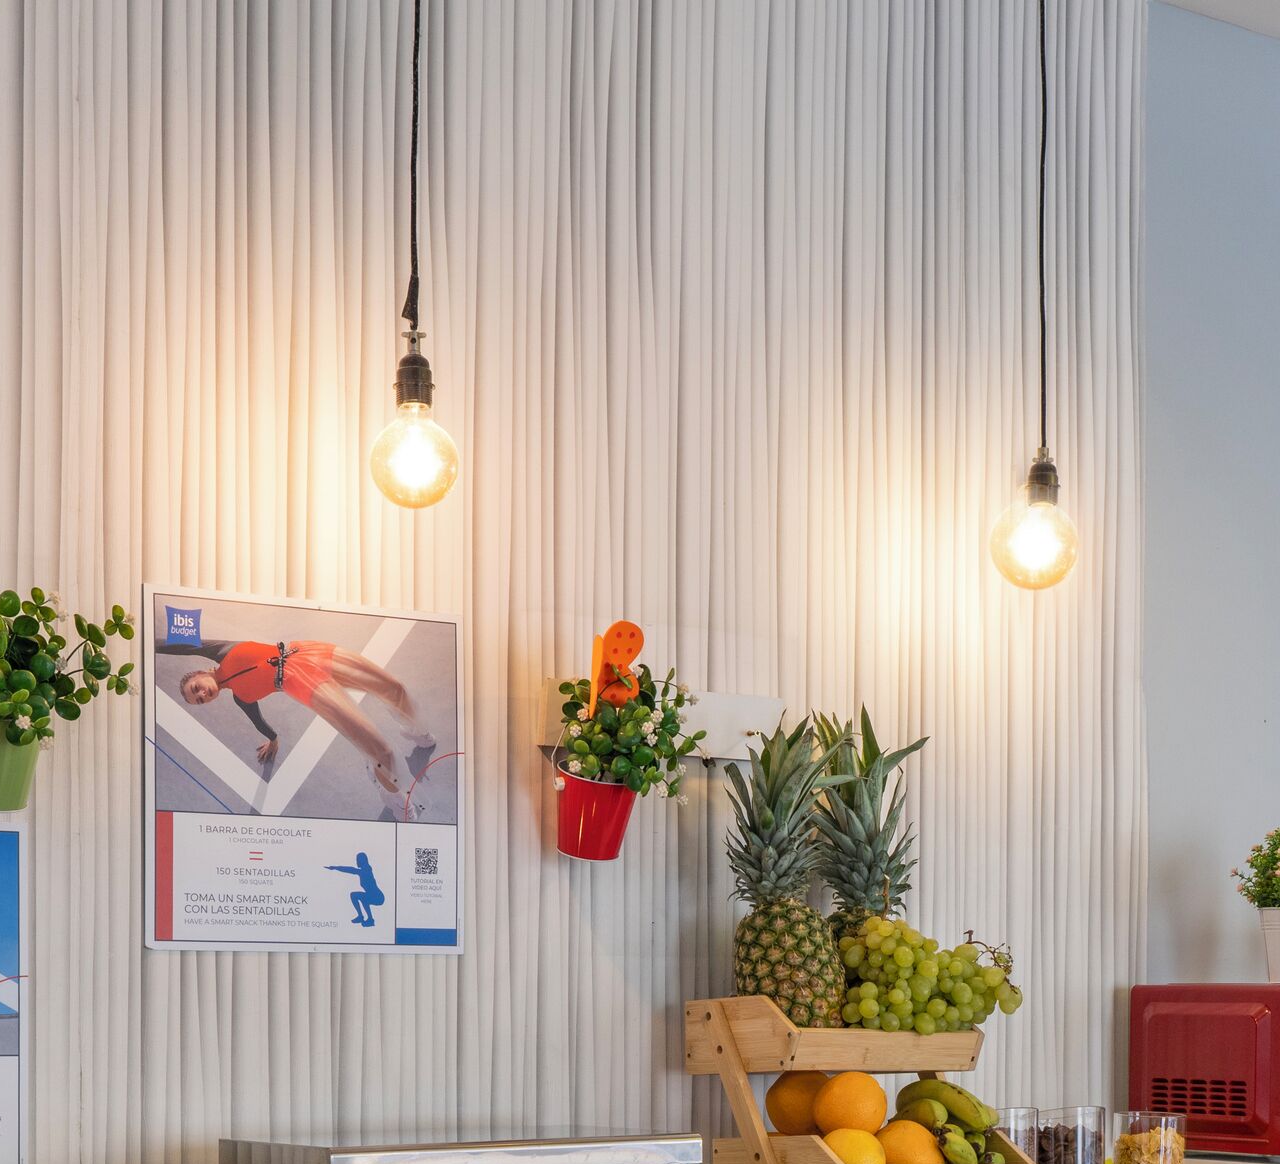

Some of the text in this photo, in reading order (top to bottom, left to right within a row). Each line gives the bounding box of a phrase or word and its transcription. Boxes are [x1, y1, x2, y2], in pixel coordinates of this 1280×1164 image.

[174, 614, 194, 627] ibis
[171, 626, 197, 636] budget
[206, 826, 238, 834] BARRA
[241, 827, 253, 835] DE
[256, 828, 312, 837] CHOCOLATE
[216, 867, 295, 877] 150 SENTADILLAS
[184, 893, 308, 905] TOMA UN SMART SNACK
[184, 905, 300, 916] CON LAS SENTADILLAS
